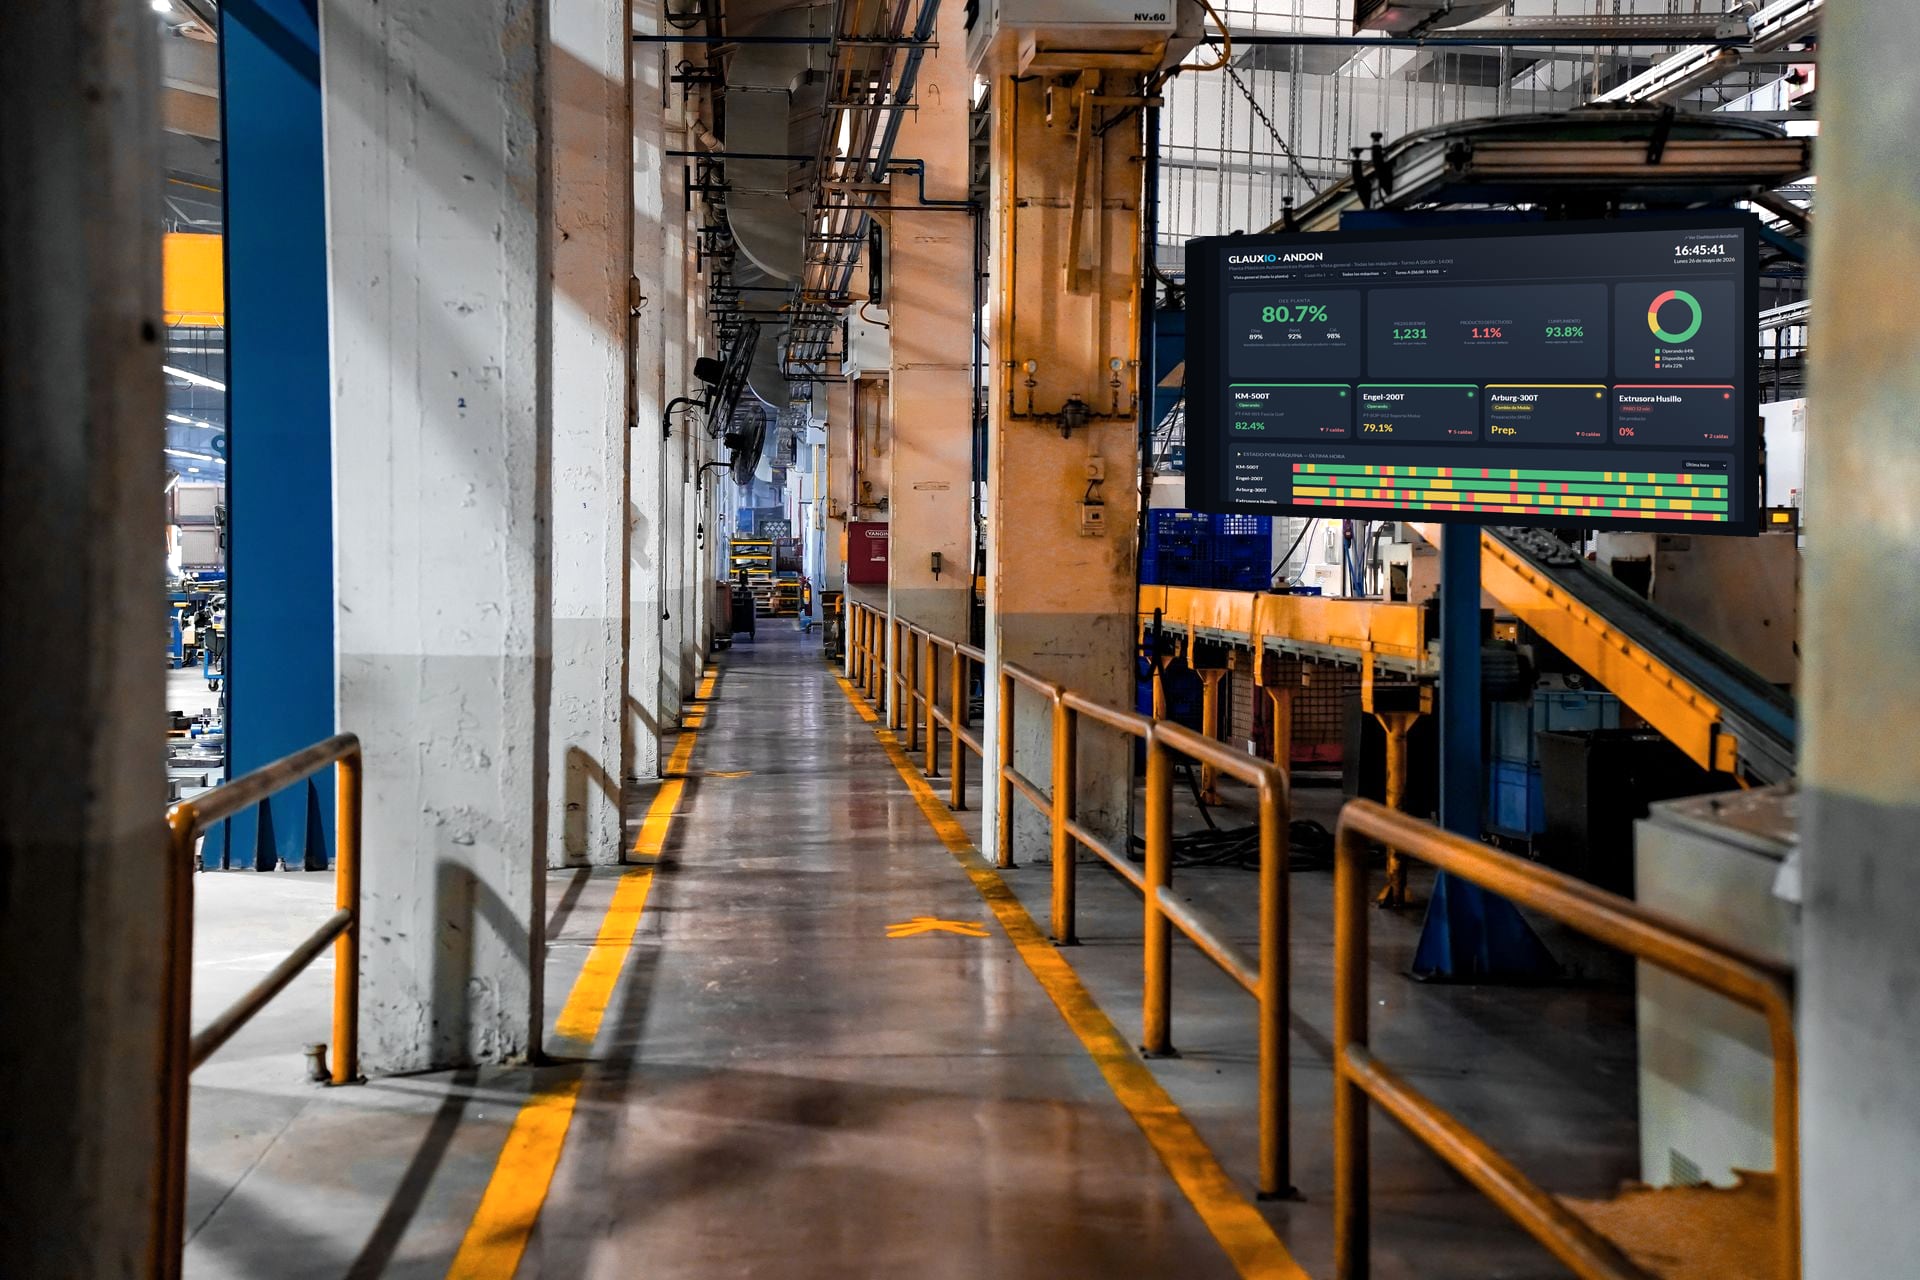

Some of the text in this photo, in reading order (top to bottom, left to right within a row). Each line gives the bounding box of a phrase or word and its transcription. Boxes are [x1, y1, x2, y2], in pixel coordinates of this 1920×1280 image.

[1674, 244, 1726, 256] 16:45:41
[1228, 254, 1276, 264] GLAUXIO
[1282, 252, 1323, 262] ANDON
[1262, 305, 1328, 322] 80.7%
[1393, 328, 1428, 340] 1,231
[1472, 327, 1502, 338] 1.1%
[1545, 326, 1584, 338] 93.8%
[1491, 394, 1538, 402] Arburg-300T
[1235, 422, 1264, 430] 82.4%
[1363, 424, 1393, 432] 79.1%
[1491, 426, 1517, 436] Prep.
[1618, 428, 1634, 437] 0%
